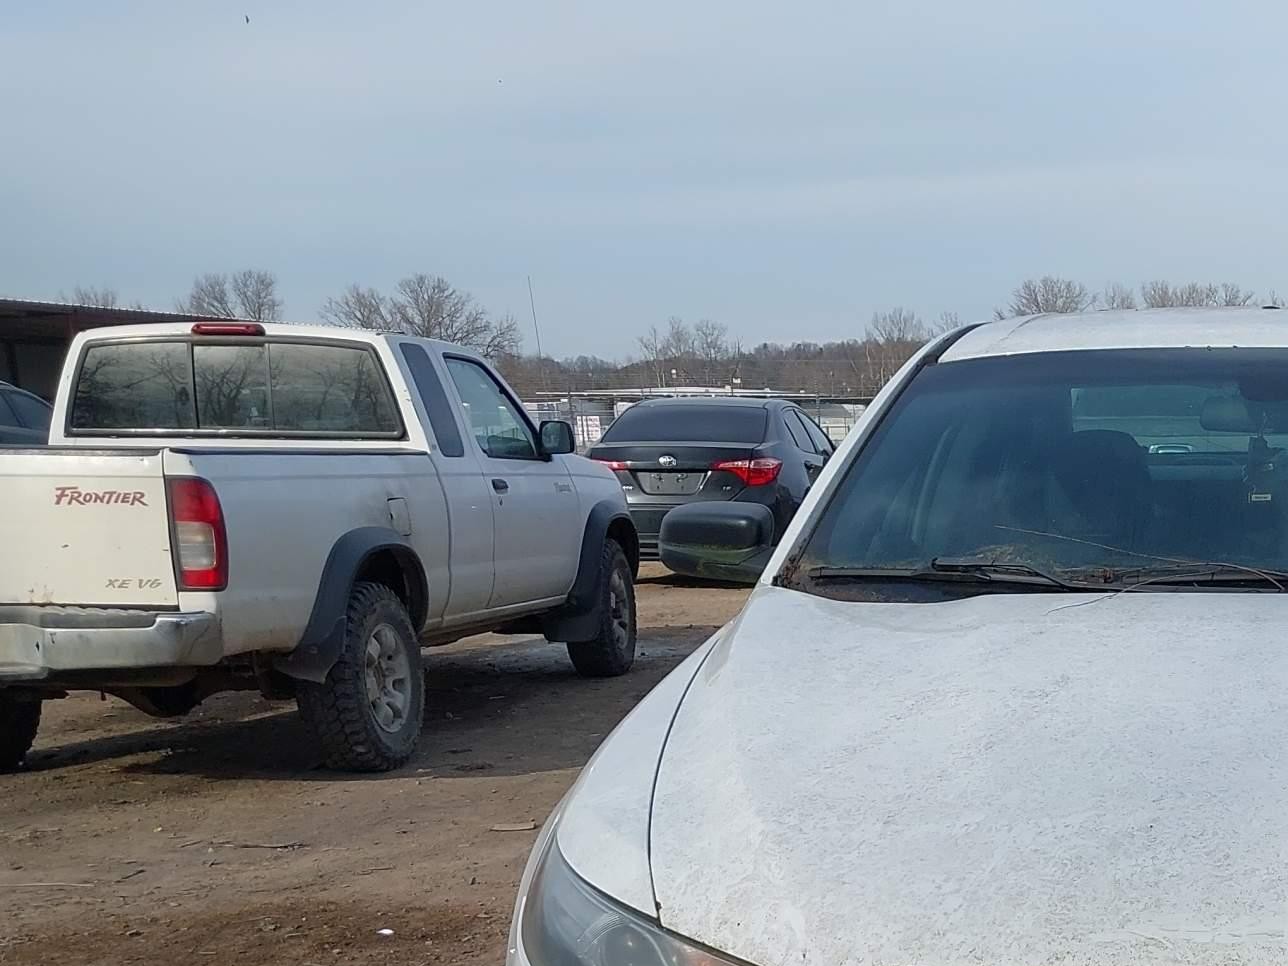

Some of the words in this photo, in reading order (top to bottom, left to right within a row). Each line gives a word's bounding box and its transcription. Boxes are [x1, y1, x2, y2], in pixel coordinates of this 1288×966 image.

[54, 486, 149, 507] FRONTIER
[105, 578, 132, 589] XE
[137, 578, 162, 590] V6
